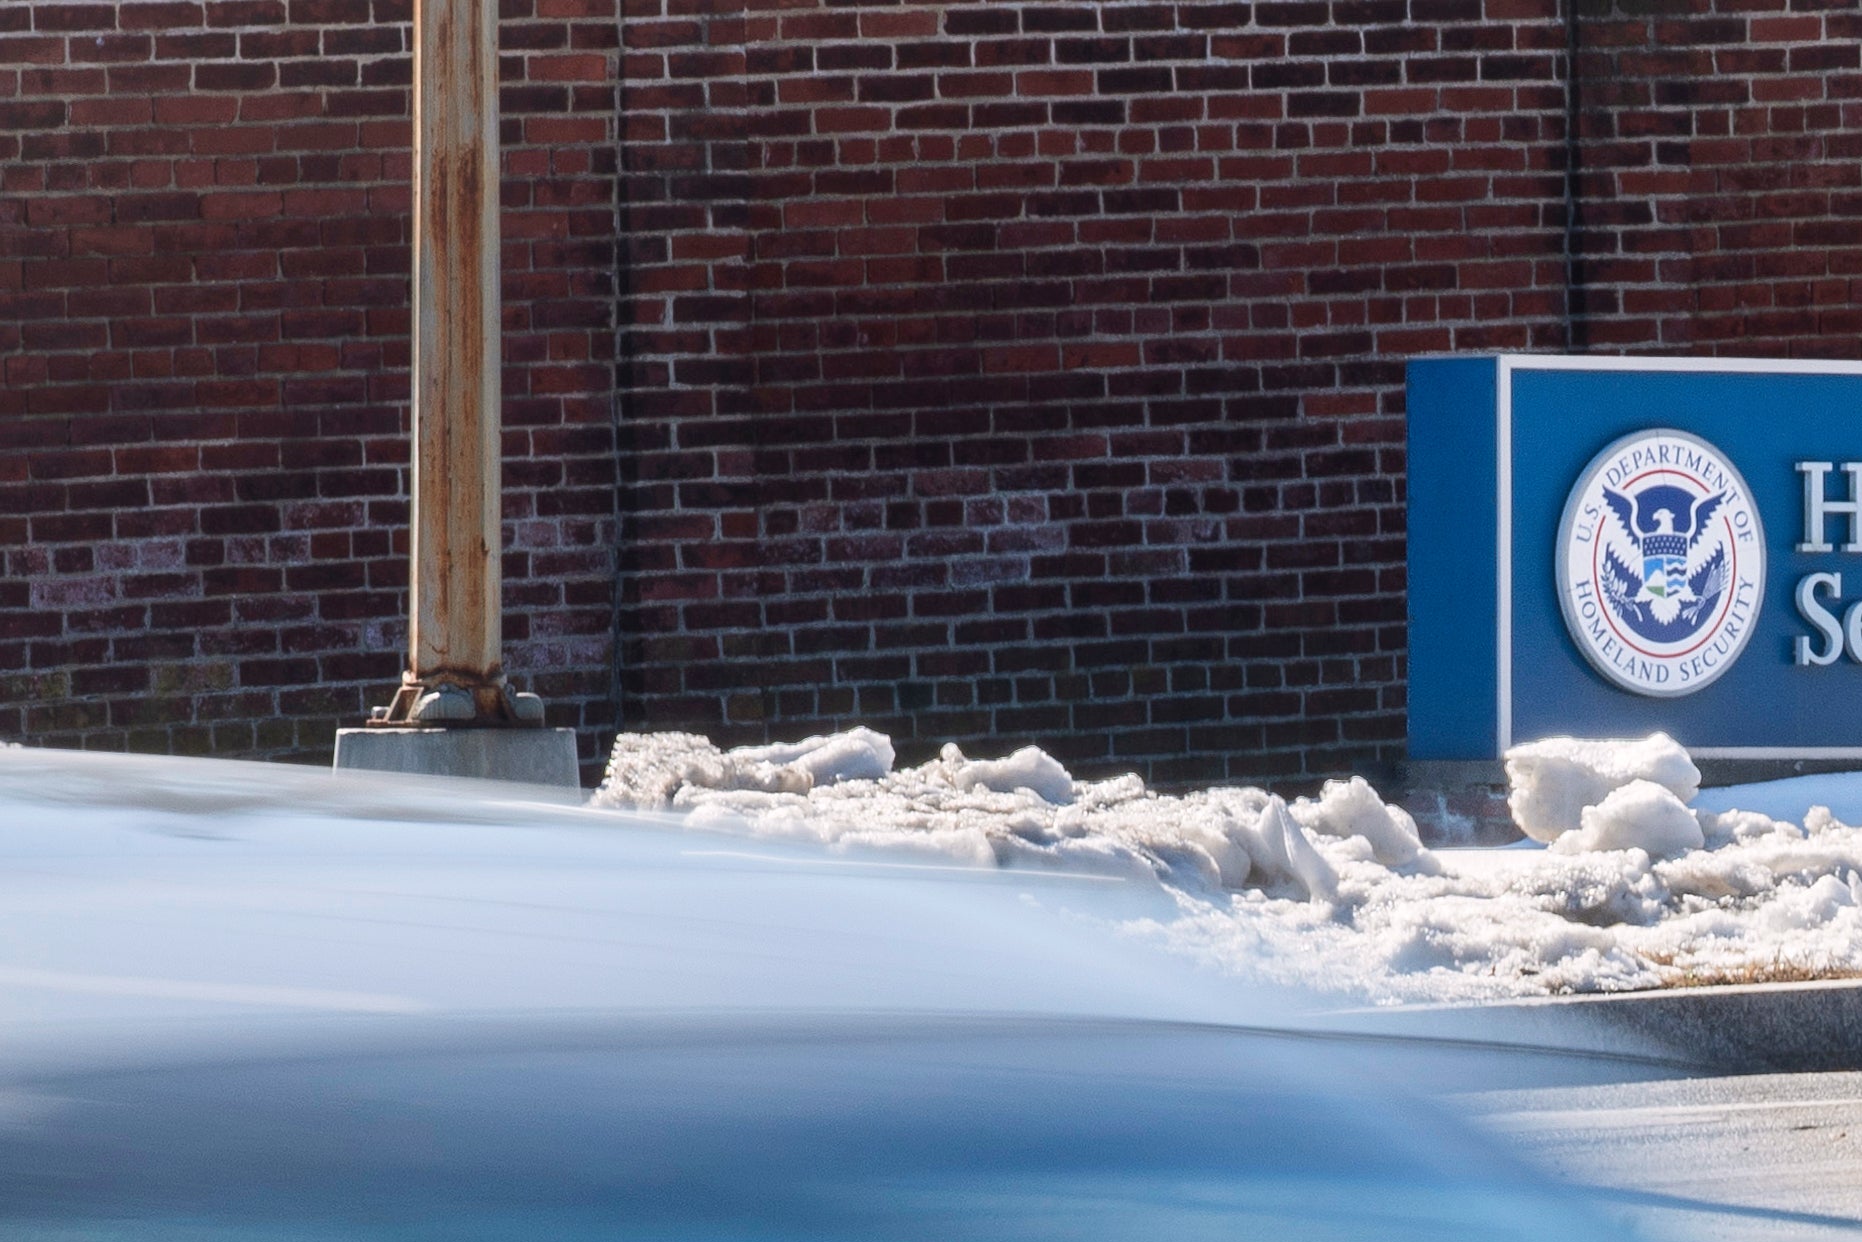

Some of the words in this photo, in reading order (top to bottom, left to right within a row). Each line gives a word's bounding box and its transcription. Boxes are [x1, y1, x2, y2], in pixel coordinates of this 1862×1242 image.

[1576, 503, 1602, 543] U.S.
[1605, 444, 1740, 505] DEPARTMENT
[1734, 510, 1753, 543] OF
[1576, 579, 1669, 683] HOMELAND
[1680, 577, 1754, 682] SECURITY
